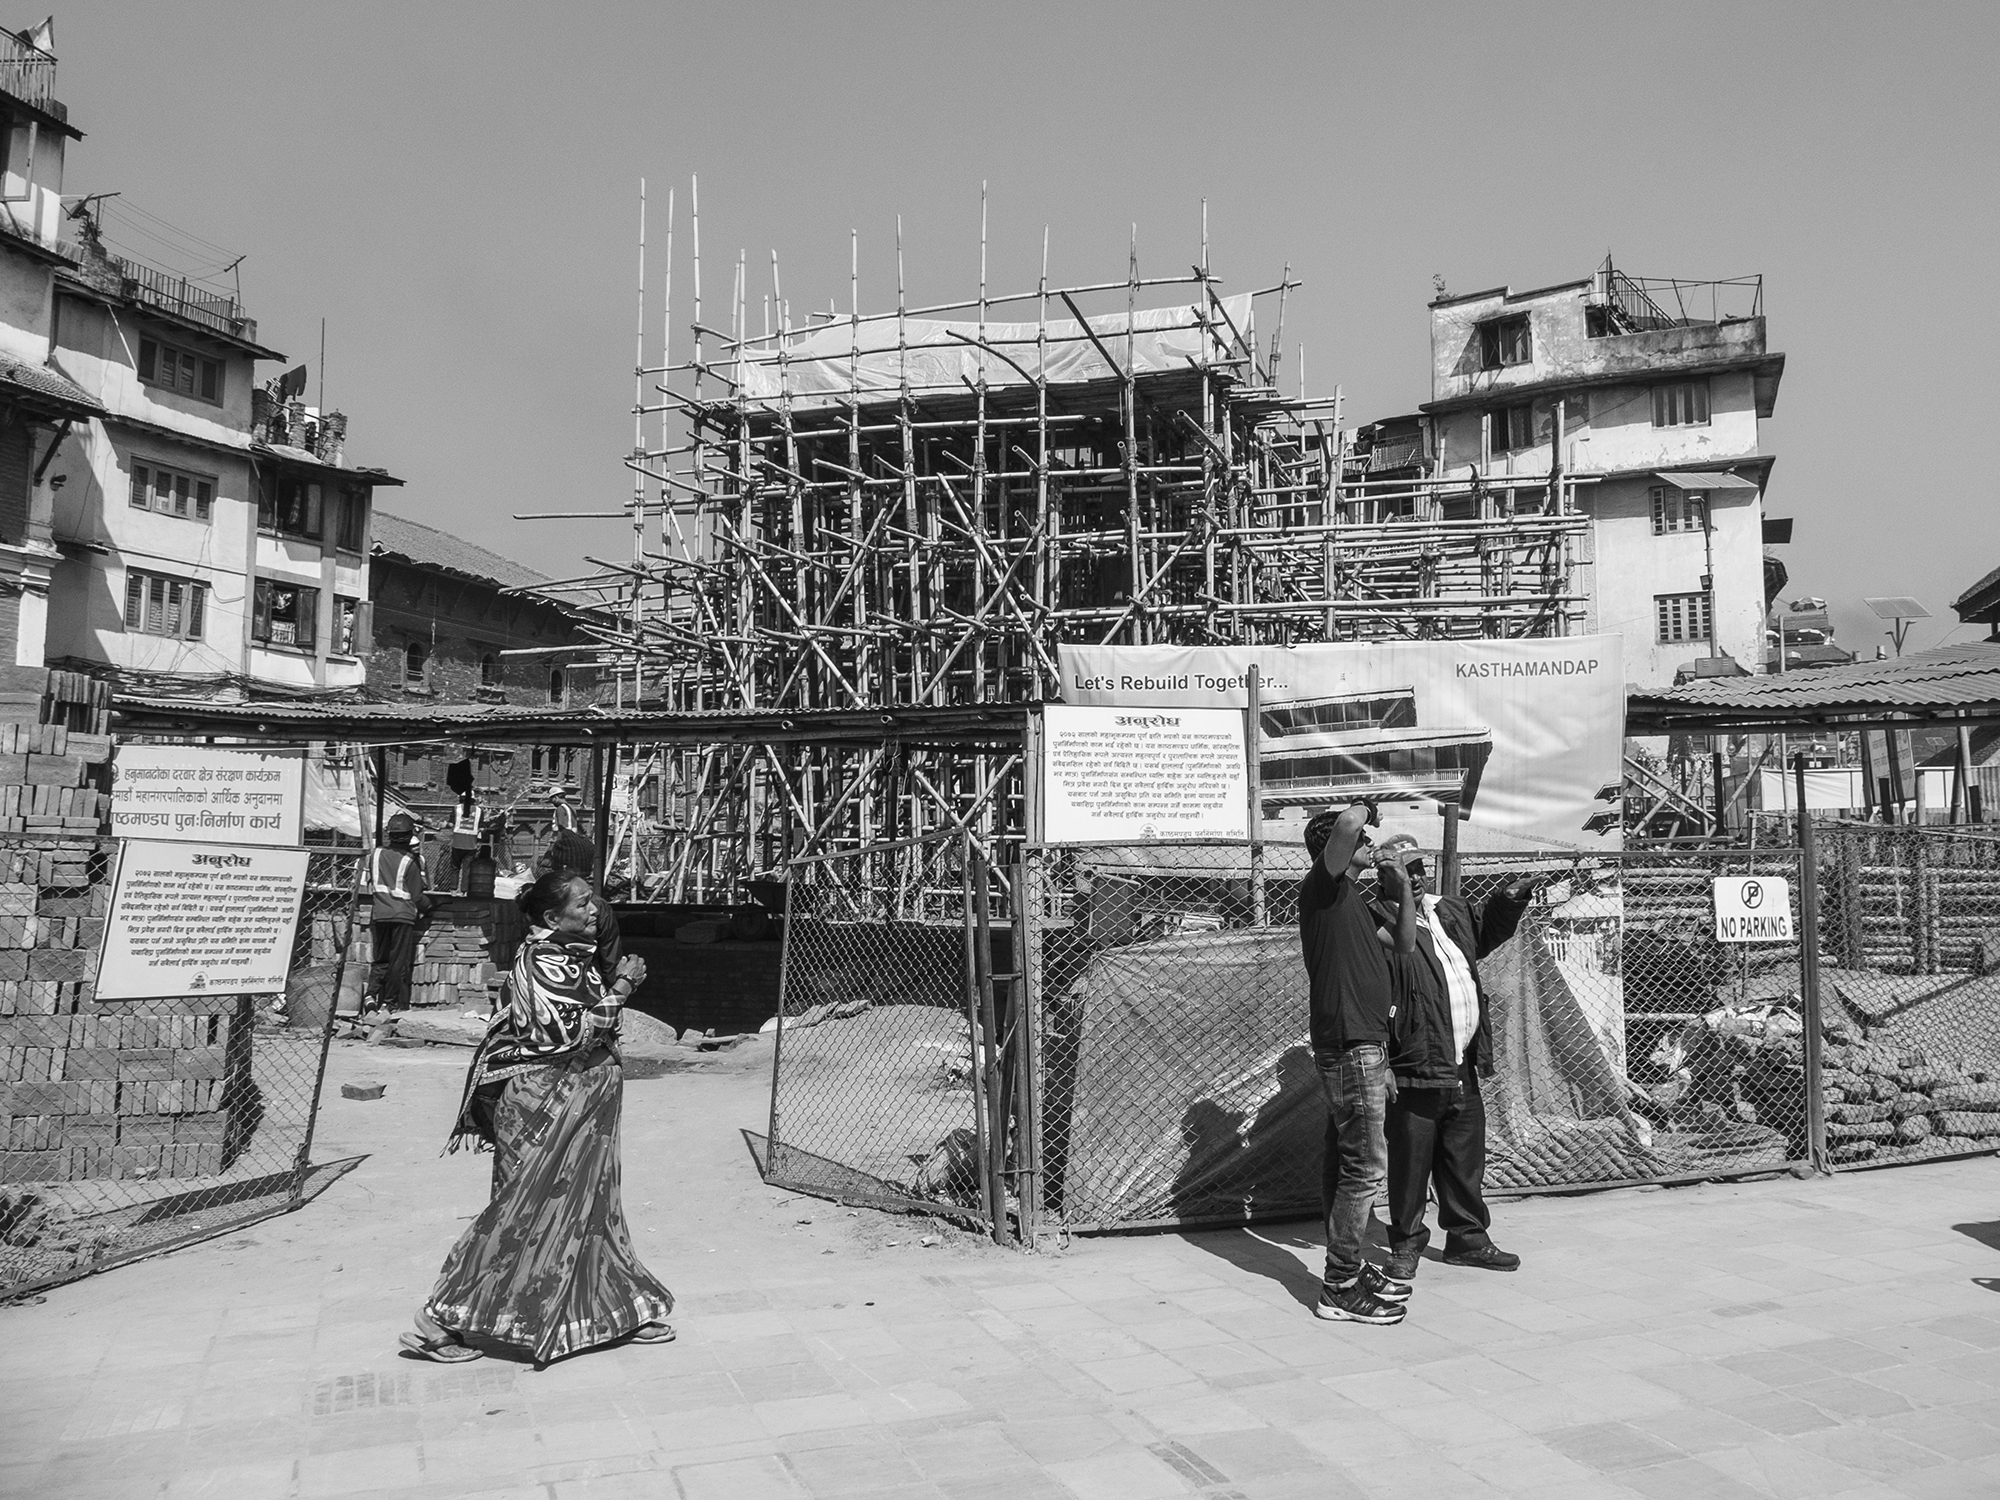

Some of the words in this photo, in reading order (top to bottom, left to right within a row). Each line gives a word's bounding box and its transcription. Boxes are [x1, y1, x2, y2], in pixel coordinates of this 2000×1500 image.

[1456, 659, 1598, 677] KASTHAMANDAP
[1075, 675, 1115, 690] Let's
[1121, 675, 1188, 690] Rebuild
[1114, 714, 1181, 729] अनुरोध
[199, 767, 213, 781] क्षेत्र
[216, 767, 243, 782] संरक्षण
[246, 768, 281, 782] कार्यक्रम
[136, 787, 207, 803] महानगरपालिकाको
[211, 788, 240, 804] आर्थिक
[244, 793, 283, 809] अनुदानमा
[111, 812, 170, 826] ाष्ठमण्डप
[250, 813, 281, 829] कार्य
[192, 853, 252, 868] अनुरोध
[1721, 917, 1737, 938] NO
[1740, 916, 1787, 938] PARKING
